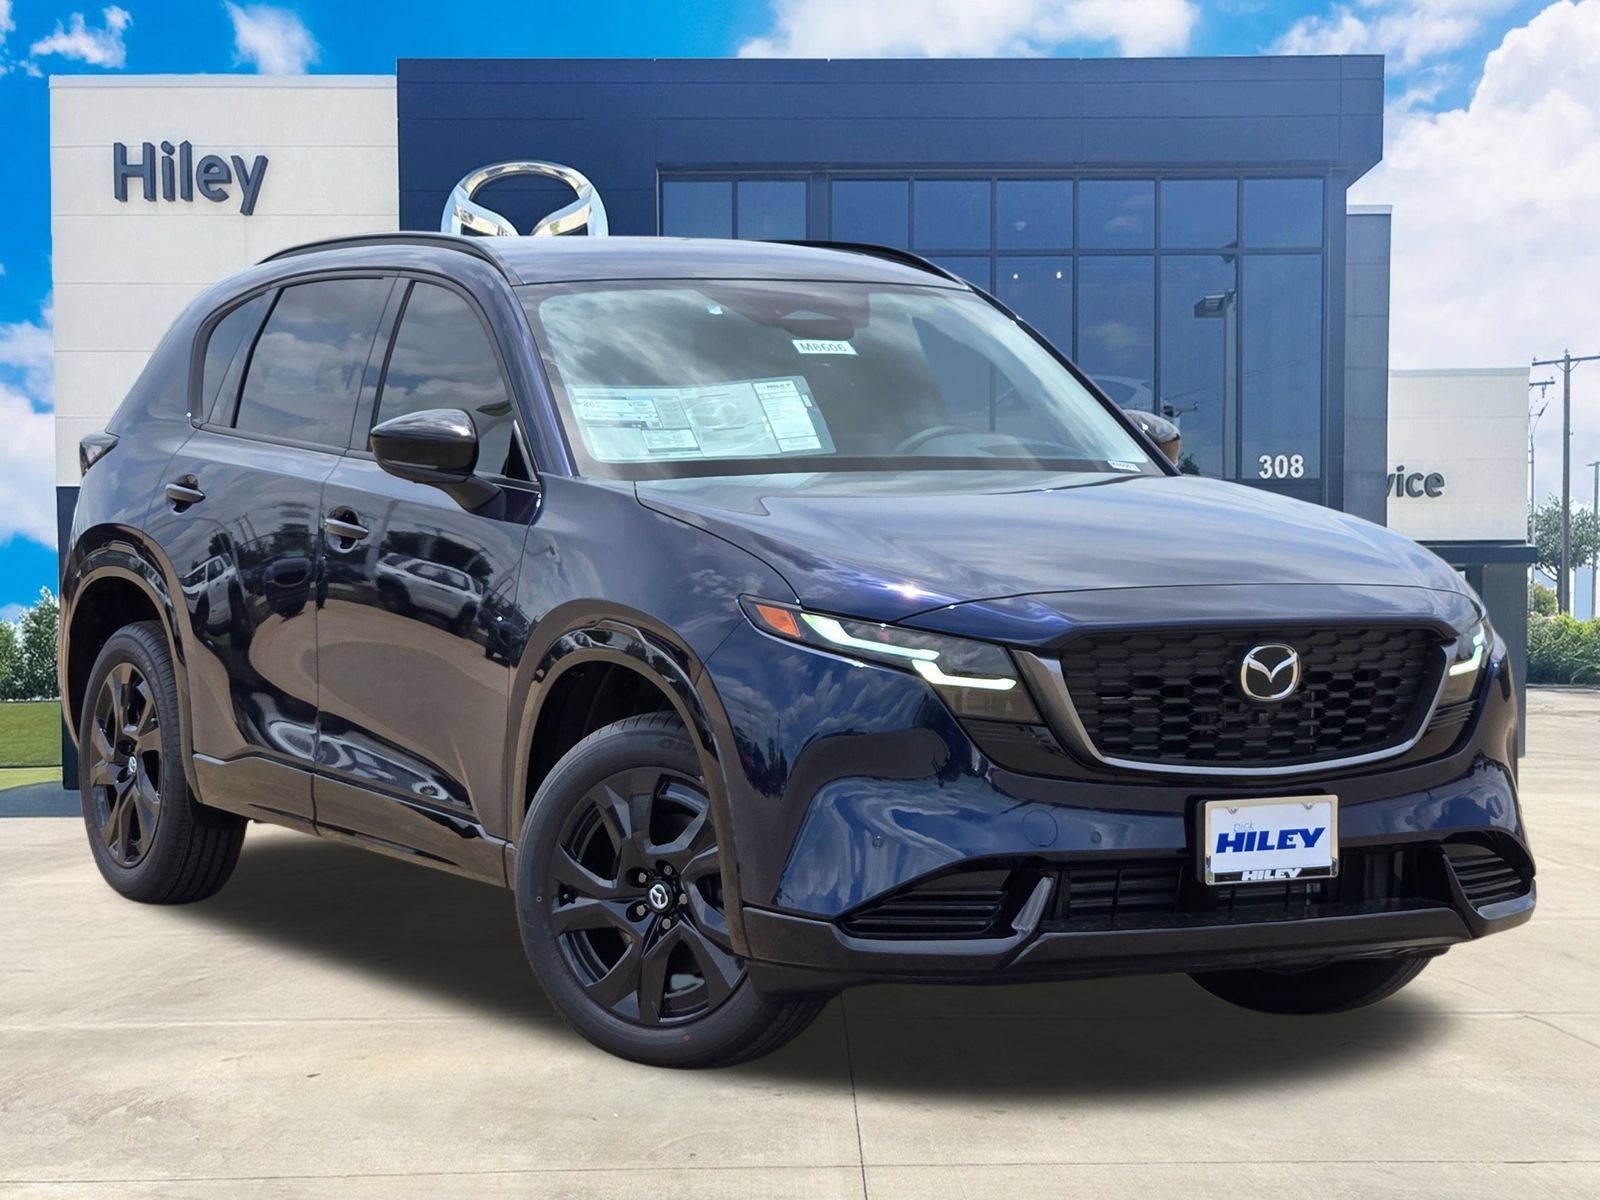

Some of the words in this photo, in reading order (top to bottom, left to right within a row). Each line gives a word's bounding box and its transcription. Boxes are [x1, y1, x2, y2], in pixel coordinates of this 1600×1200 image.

[113, 139, 269, 216] Hiley
[1258, 454, 1304, 479] 308
[1216, 827, 1326, 853] HILEY
[1241, 867, 1302, 881] HILEY
